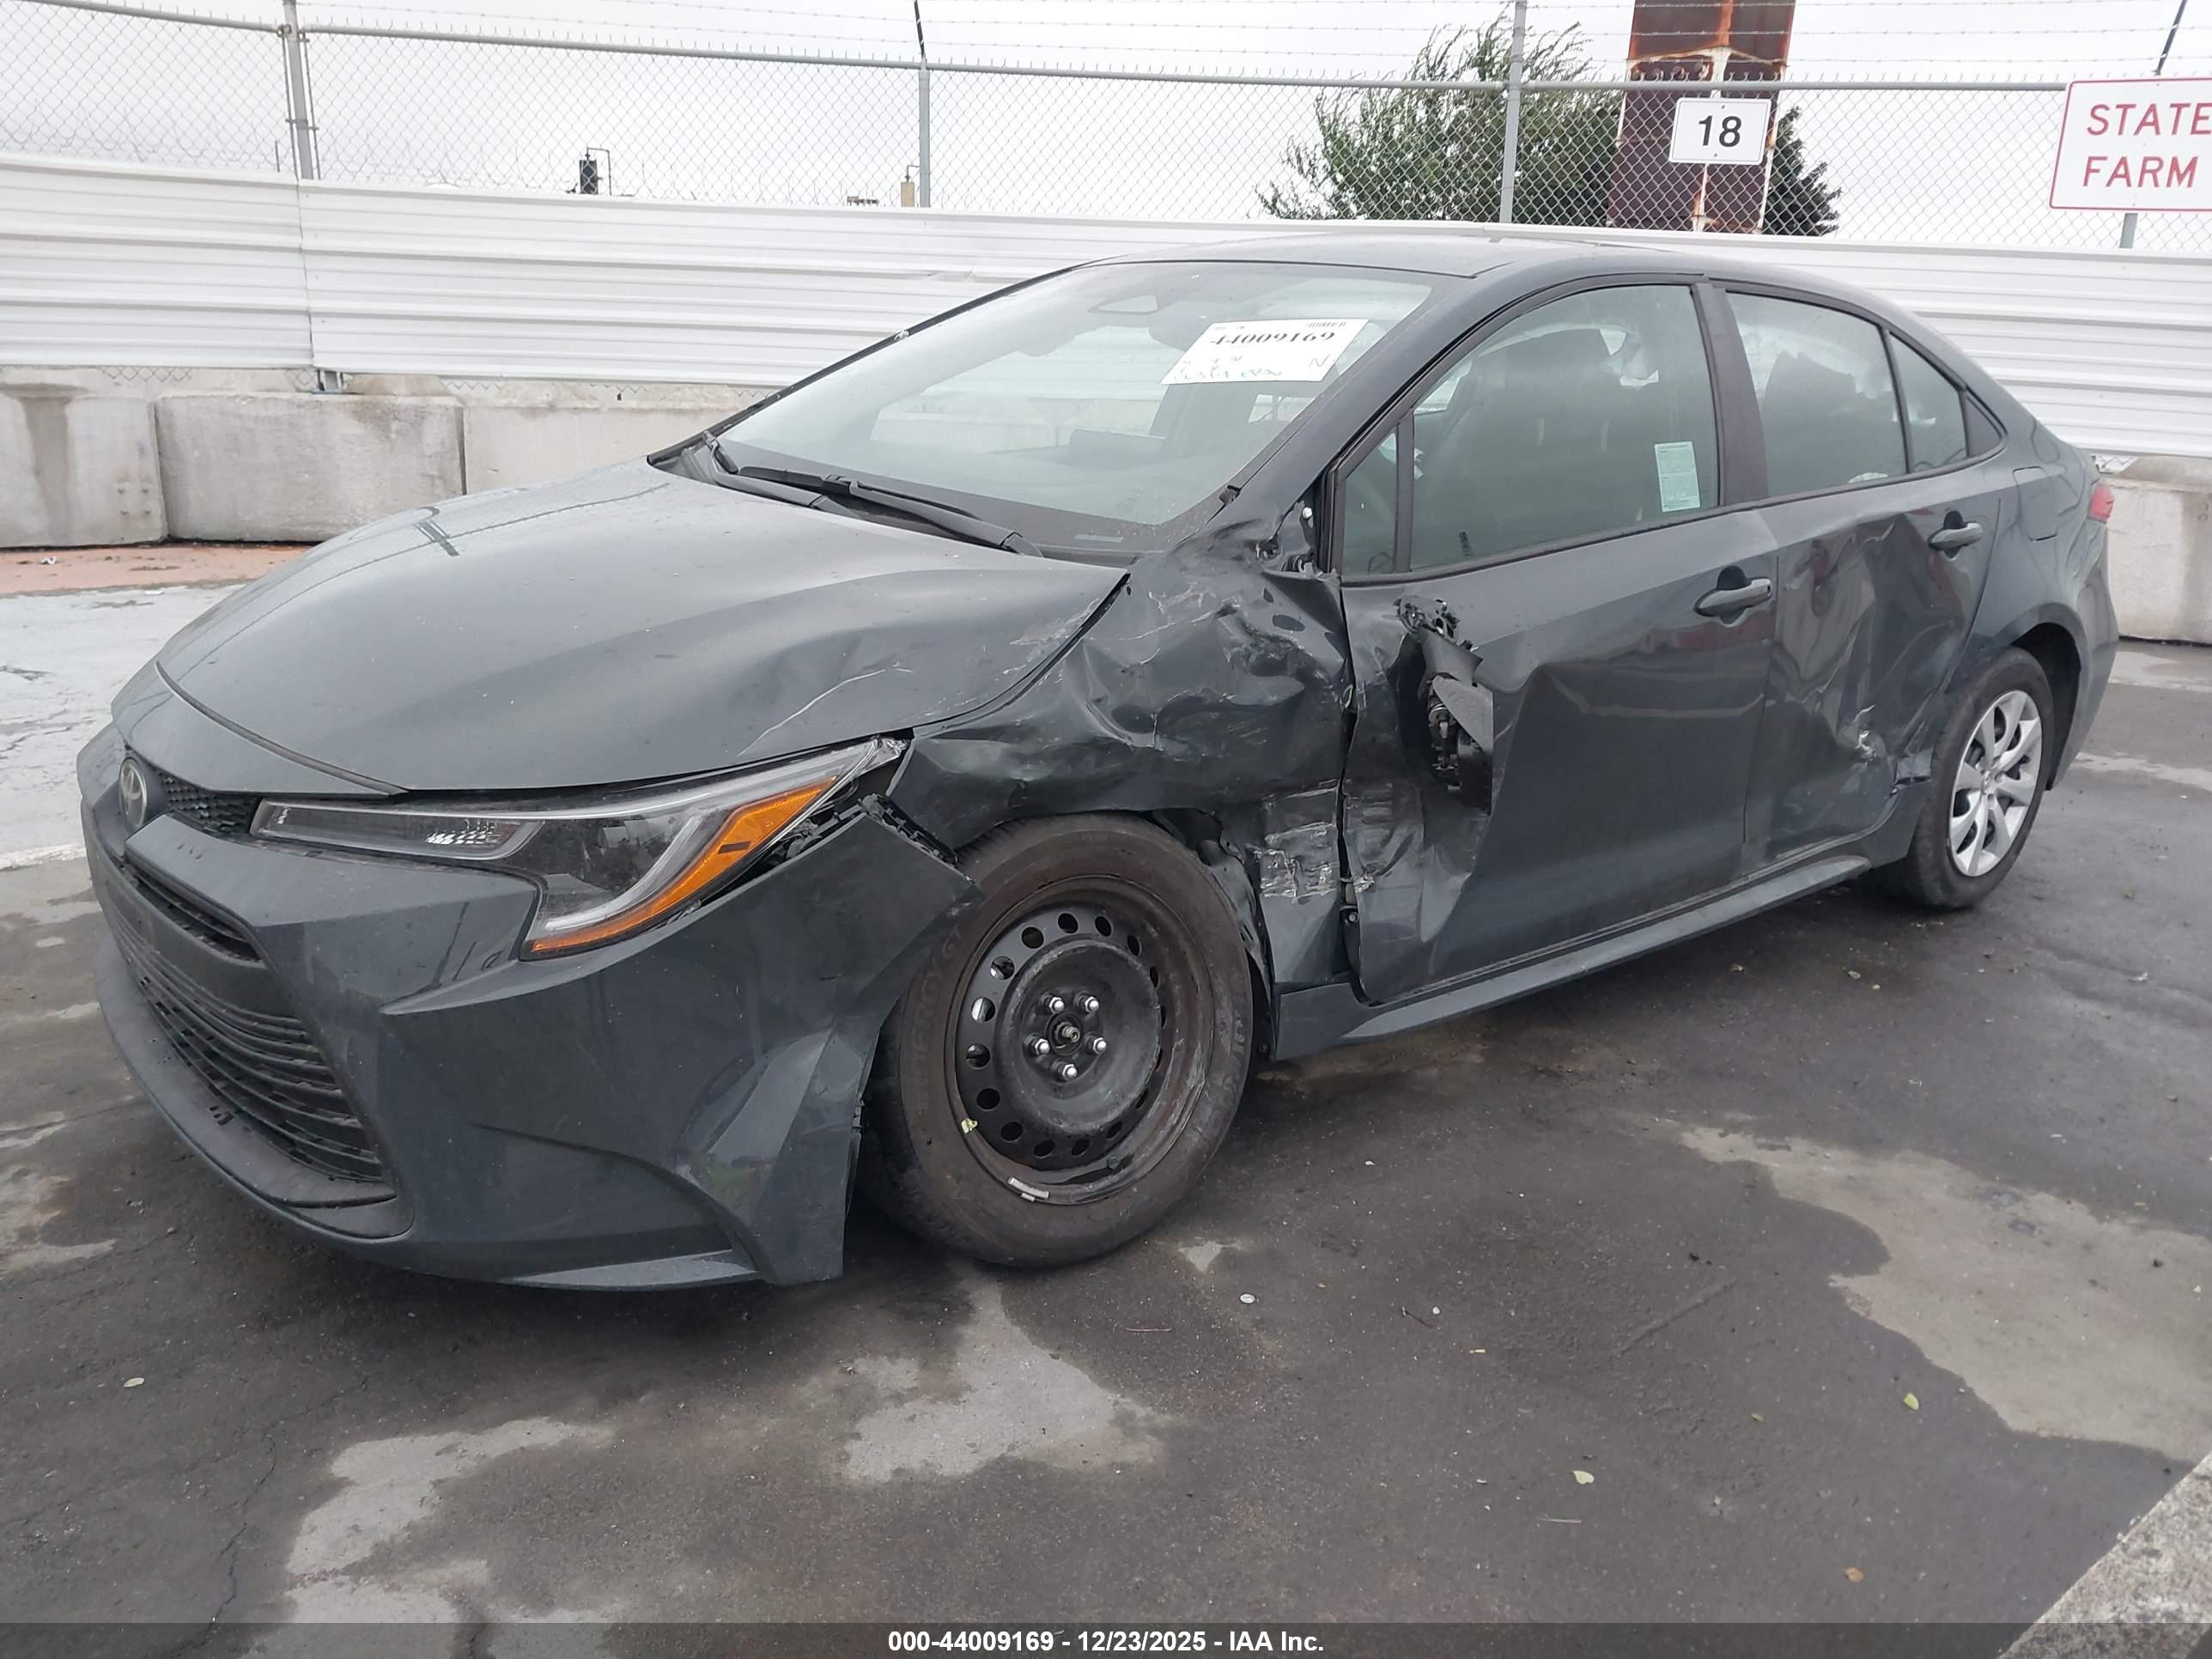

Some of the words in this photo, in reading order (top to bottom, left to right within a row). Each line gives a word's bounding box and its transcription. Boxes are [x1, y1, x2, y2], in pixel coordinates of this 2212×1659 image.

[1698, 115, 1741, 148] 18
[2087, 102, 2212, 136] STATE
[2082, 155, 2199, 188] FARM
